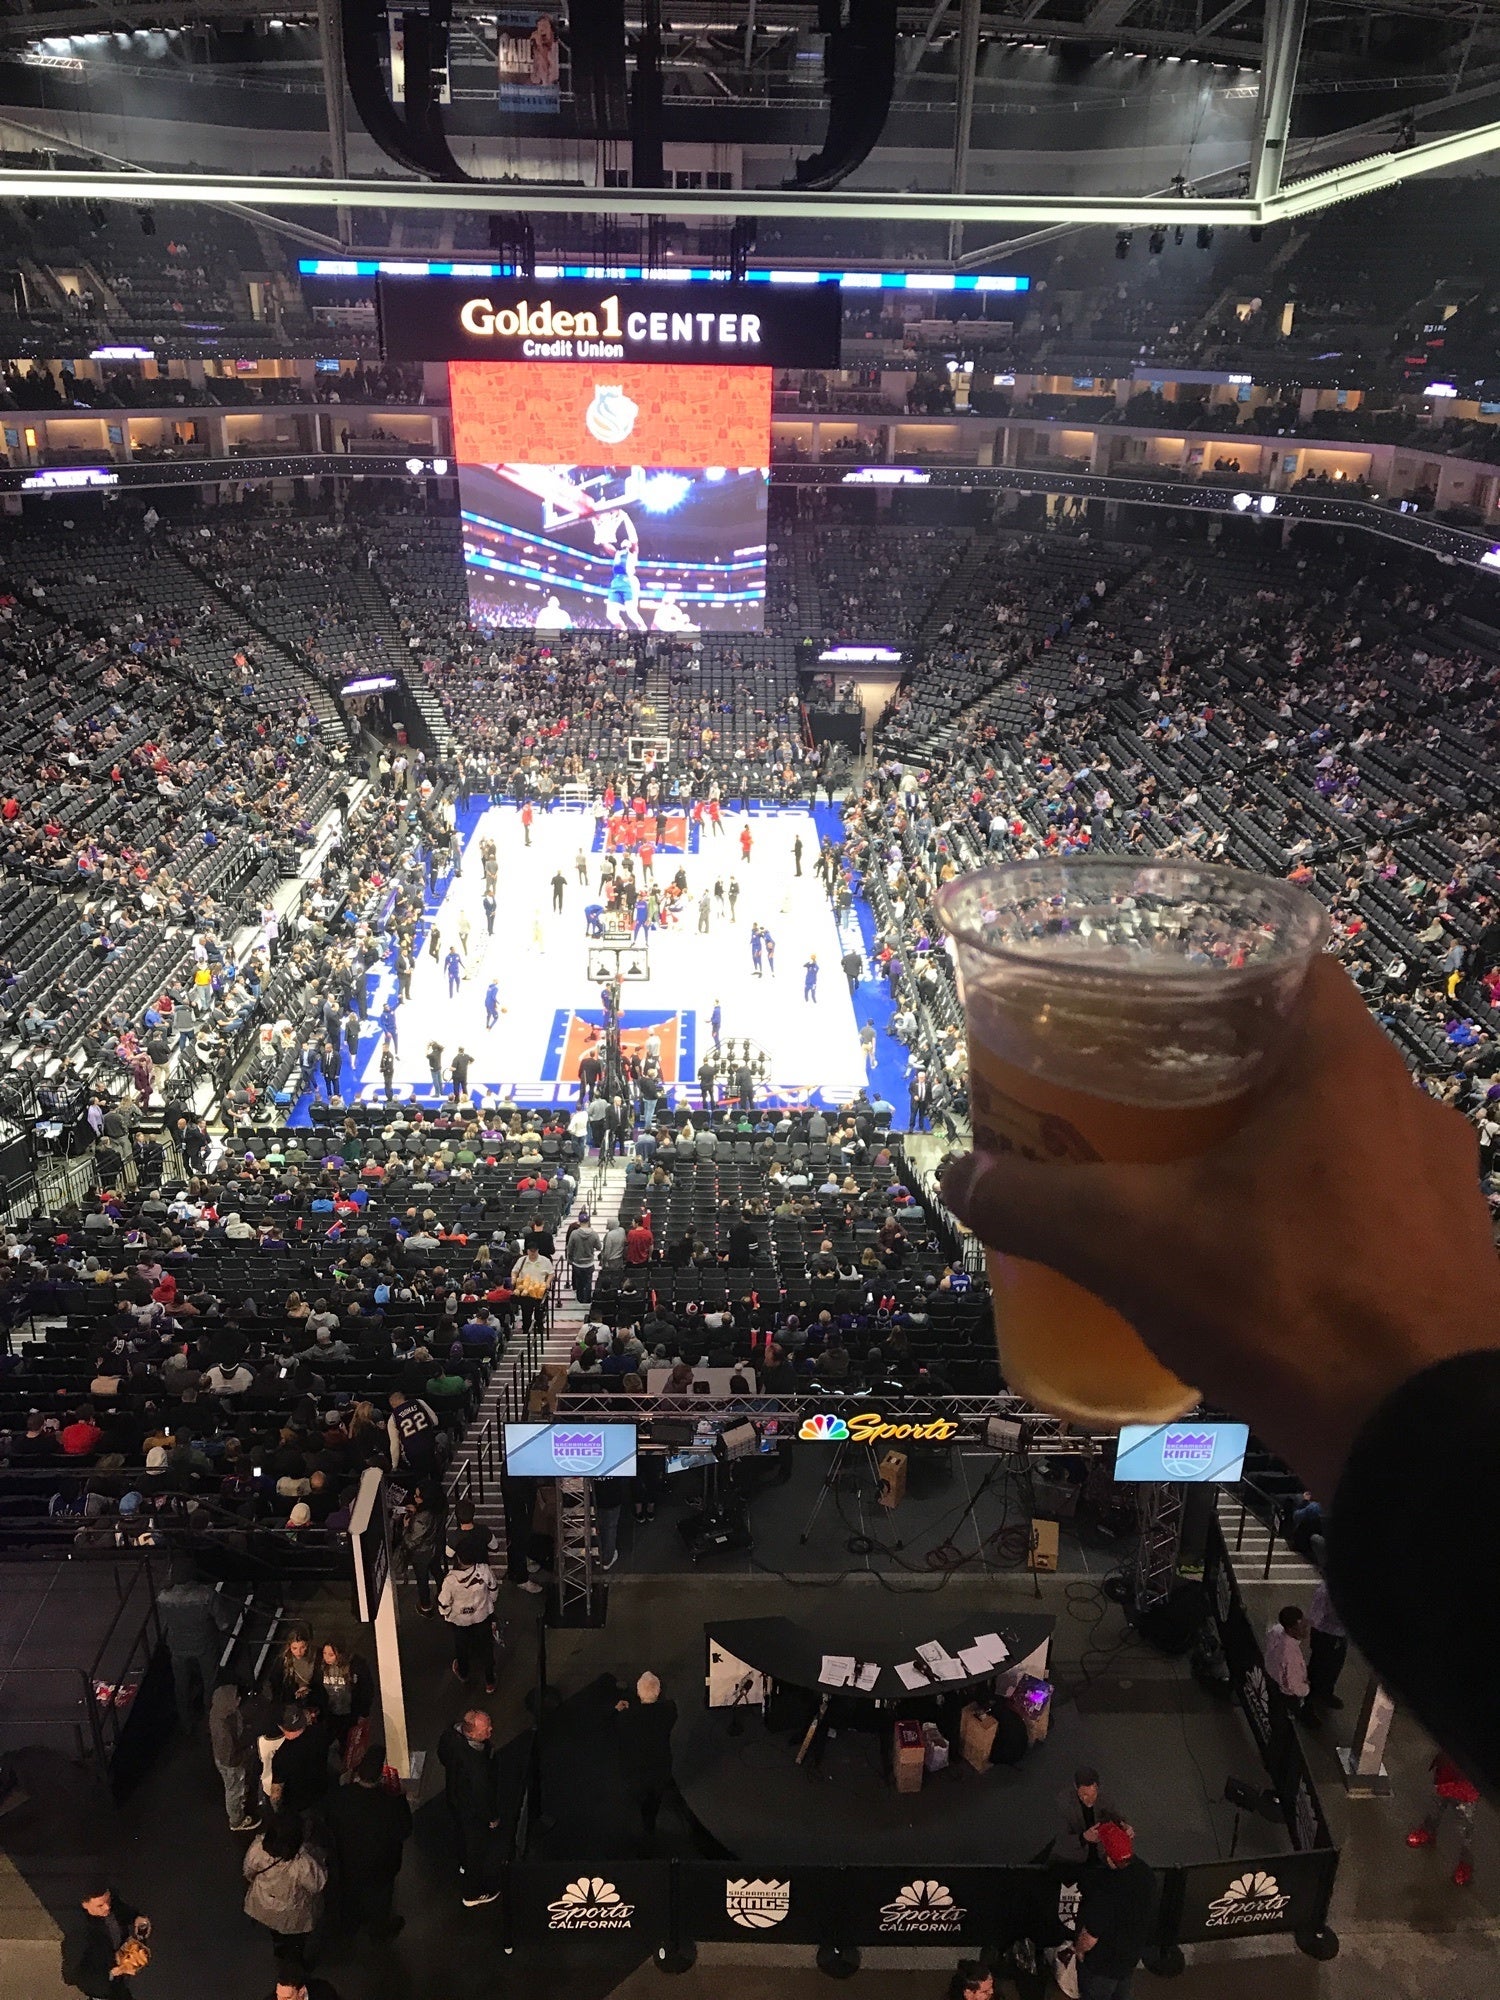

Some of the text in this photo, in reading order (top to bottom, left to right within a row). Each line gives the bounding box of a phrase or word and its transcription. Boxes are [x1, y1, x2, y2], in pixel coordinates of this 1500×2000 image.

[627, 312, 761, 343] CENTER
[523, 339, 624, 358] Credit Union
[401, 1412, 428, 1438] 22
[848, 1413, 958, 1446] Sports
[554, 1448, 602, 1457] KINGS
[1163, 1450, 1212, 1459] KINGS
[547, 1900, 635, 1924] Sports
[726, 1897, 790, 1910] KINGS
[1208, 1894, 1291, 1920] Sports
[880, 1903, 968, 1925] Sports
[1205, 1910, 1284, 1927] CALIFORNIA
[548, 1920, 632, 1929] CALIFORNIA
[879, 1923, 961, 1932] CALIFORNIA
